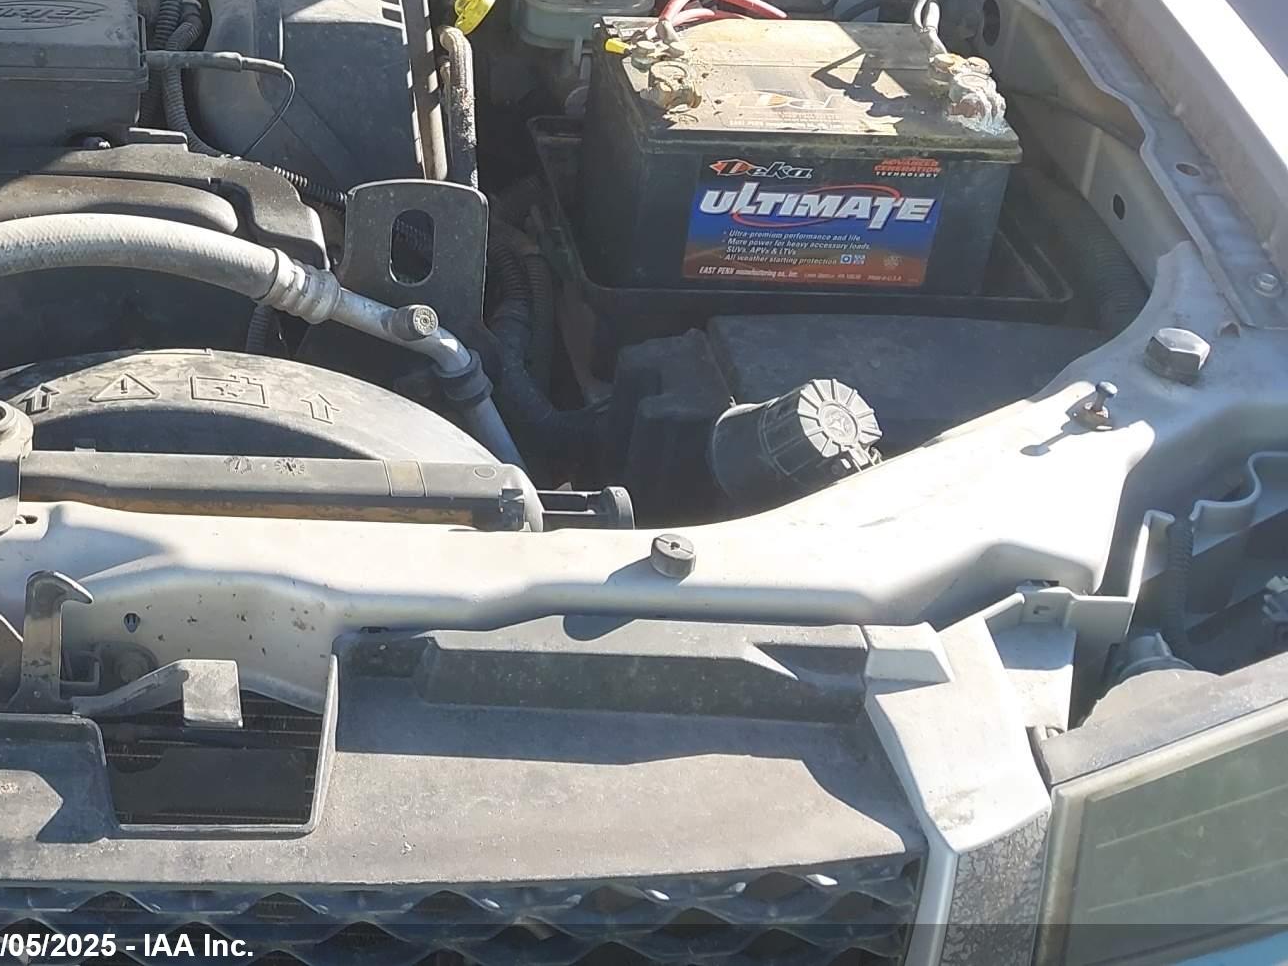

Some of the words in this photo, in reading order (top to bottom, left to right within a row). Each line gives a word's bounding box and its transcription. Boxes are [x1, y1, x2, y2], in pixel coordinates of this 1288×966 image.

[710, 159, 813, 179] Deka
[700, 182, 935, 230] ULTIMATE
[729, 229, 782, 240] Ultra-premium
[783, 233, 832, 241] performance
[727, 238, 747, 246] More
[748, 240, 774, 248] power
[774, 239, 785, 247] for
[786, 240, 809, 250] heavy
[810, 242, 848, 251] accessory
[771, 247, 778, 255] &
[724, 254, 737, 262] All
[737, 255, 767, 263] weather
[768, 256, 797, 265] starting
[700, 266, 717, 274] EAST
[718, 267, 735, 275] PENN
